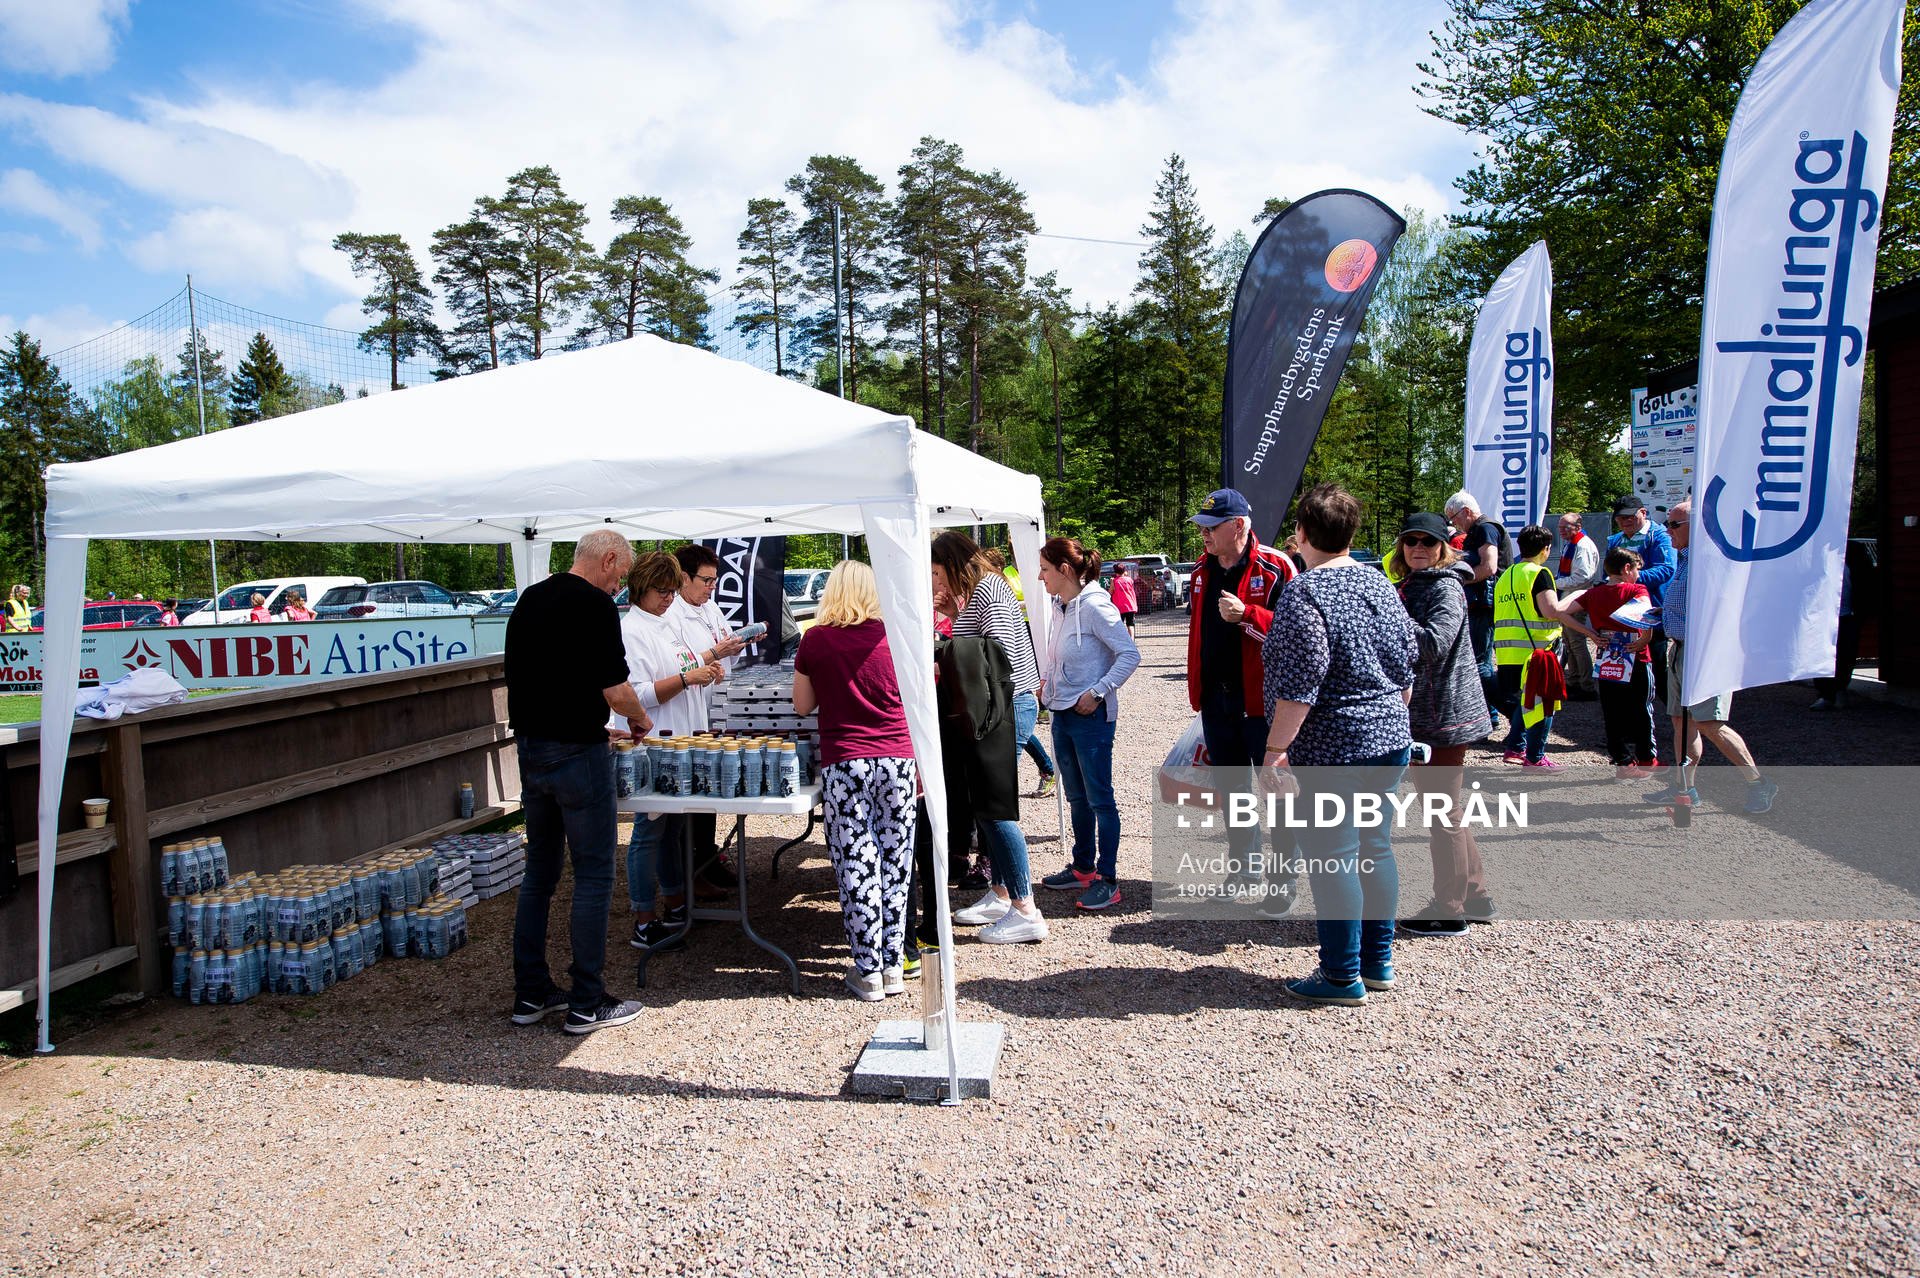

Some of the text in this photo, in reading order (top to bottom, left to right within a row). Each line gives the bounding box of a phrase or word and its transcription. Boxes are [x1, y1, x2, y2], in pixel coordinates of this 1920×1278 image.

[1244, 307, 1325, 475] Snapphanebygdens
[1296, 314, 1345, 402] Sparbank
[1702, 130, 1878, 562] Emmaljunga
[1472, 327, 1550, 563] mmaljunga
[10, 683, 43, 692] VITTS
[166, 630, 468, 680] NIBE AirSite
